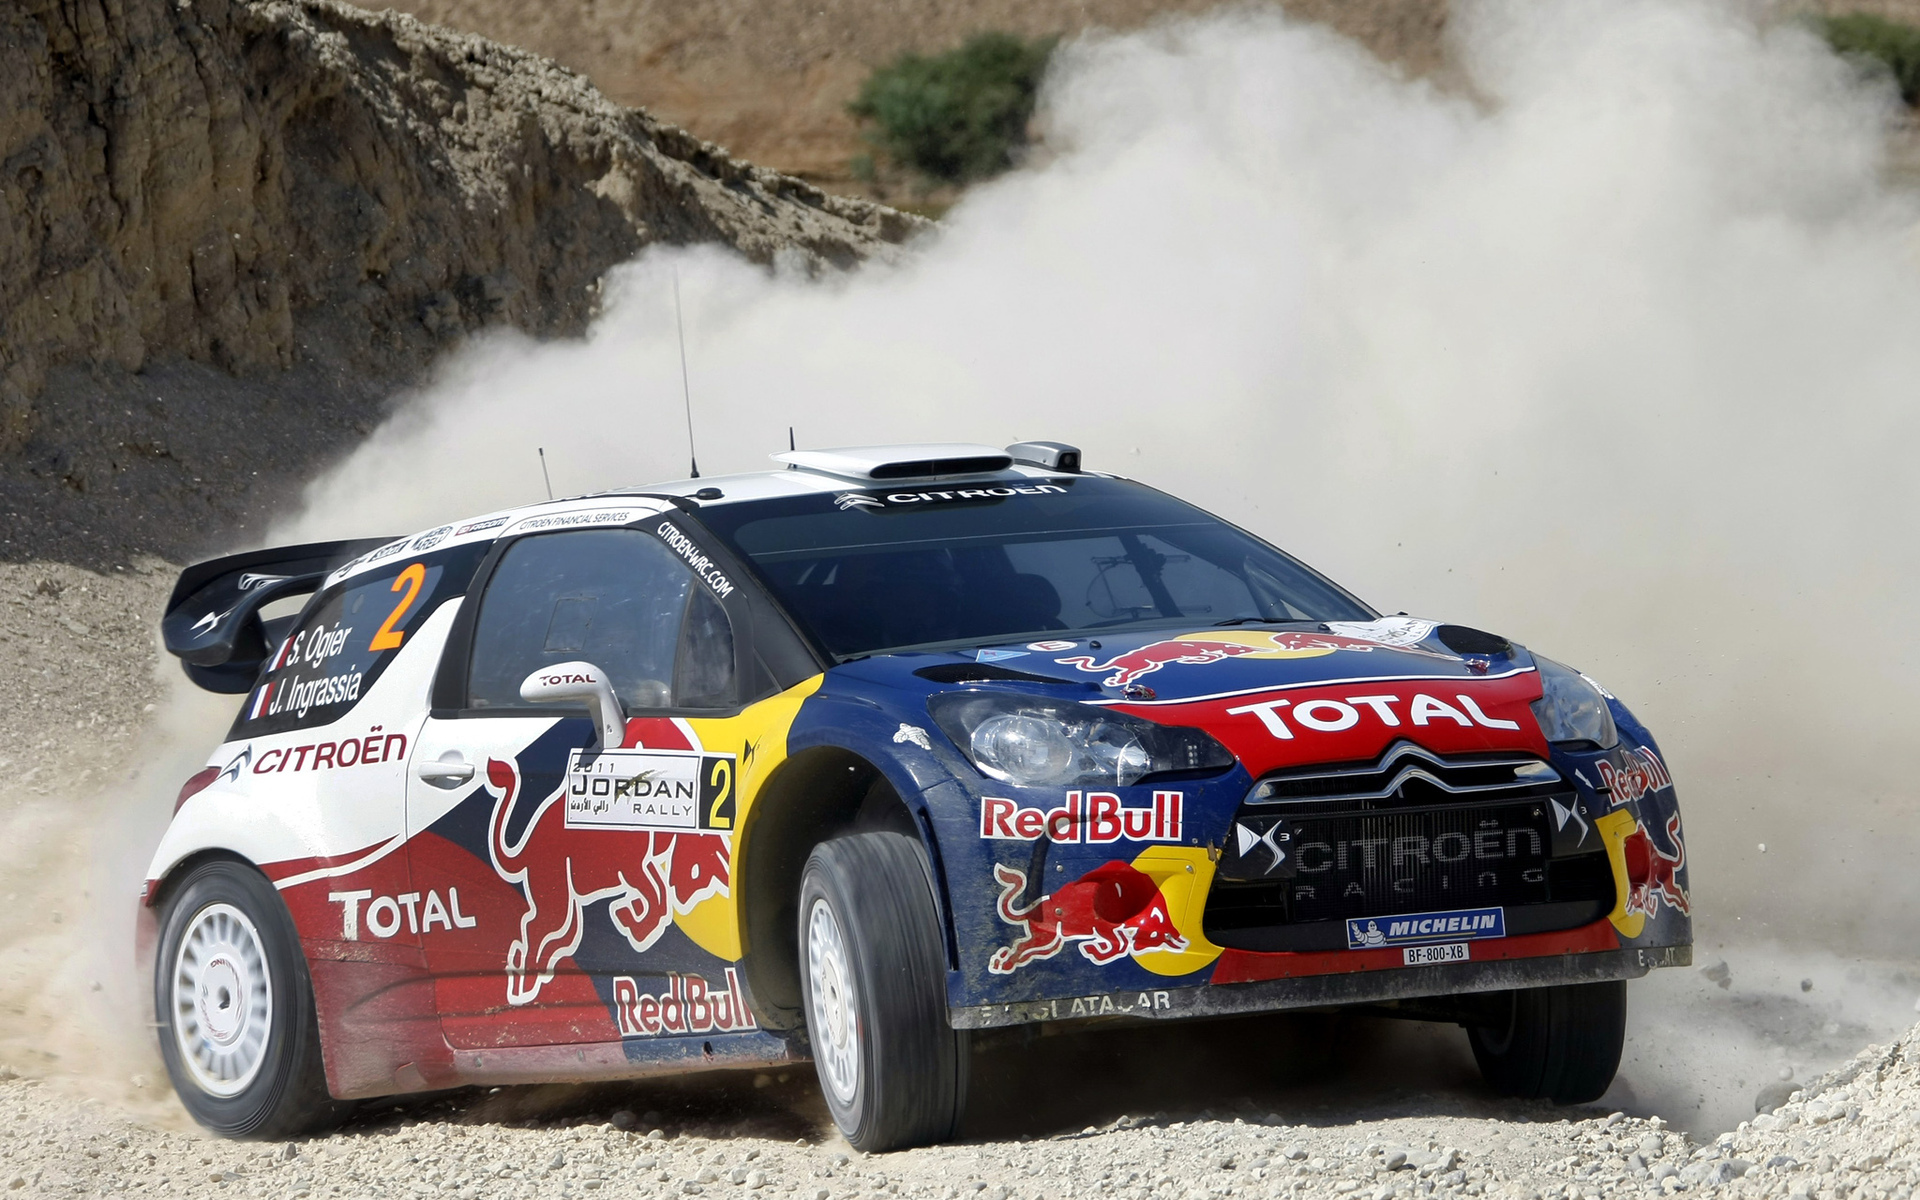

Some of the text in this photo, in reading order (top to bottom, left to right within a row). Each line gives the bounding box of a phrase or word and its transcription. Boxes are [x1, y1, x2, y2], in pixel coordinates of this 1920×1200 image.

[551, 513, 591, 526] FINANCIAL
[592, 511, 630, 524] SERVICES
[657, 521, 735, 599] CITROEN-WRC.COM
[368, 562, 427, 652] 2
[286, 621, 354, 669] S. Ogier
[268, 664, 362, 719] J. Ingrassia
[539, 674, 597, 687] TOTAL
[1225, 693, 1520, 740] TOTAL
[252, 725, 408, 774] CITROËN
[572, 762, 616, 774] 2011
[571, 774, 694, 800] JORDAN
[708, 759, 732, 828] 2
[1596, 746, 1671, 805] Red Bull
[632, 803, 693, 816] RALLY
[982, 791, 1181, 842] Red Bull
[328, 886, 476, 941] TOTAL
[1389, 915, 1496, 937] MICHELIN
[1407, 944, 1464, 964] BF-800-XB
[613, 968, 757, 1035] Red Bull
